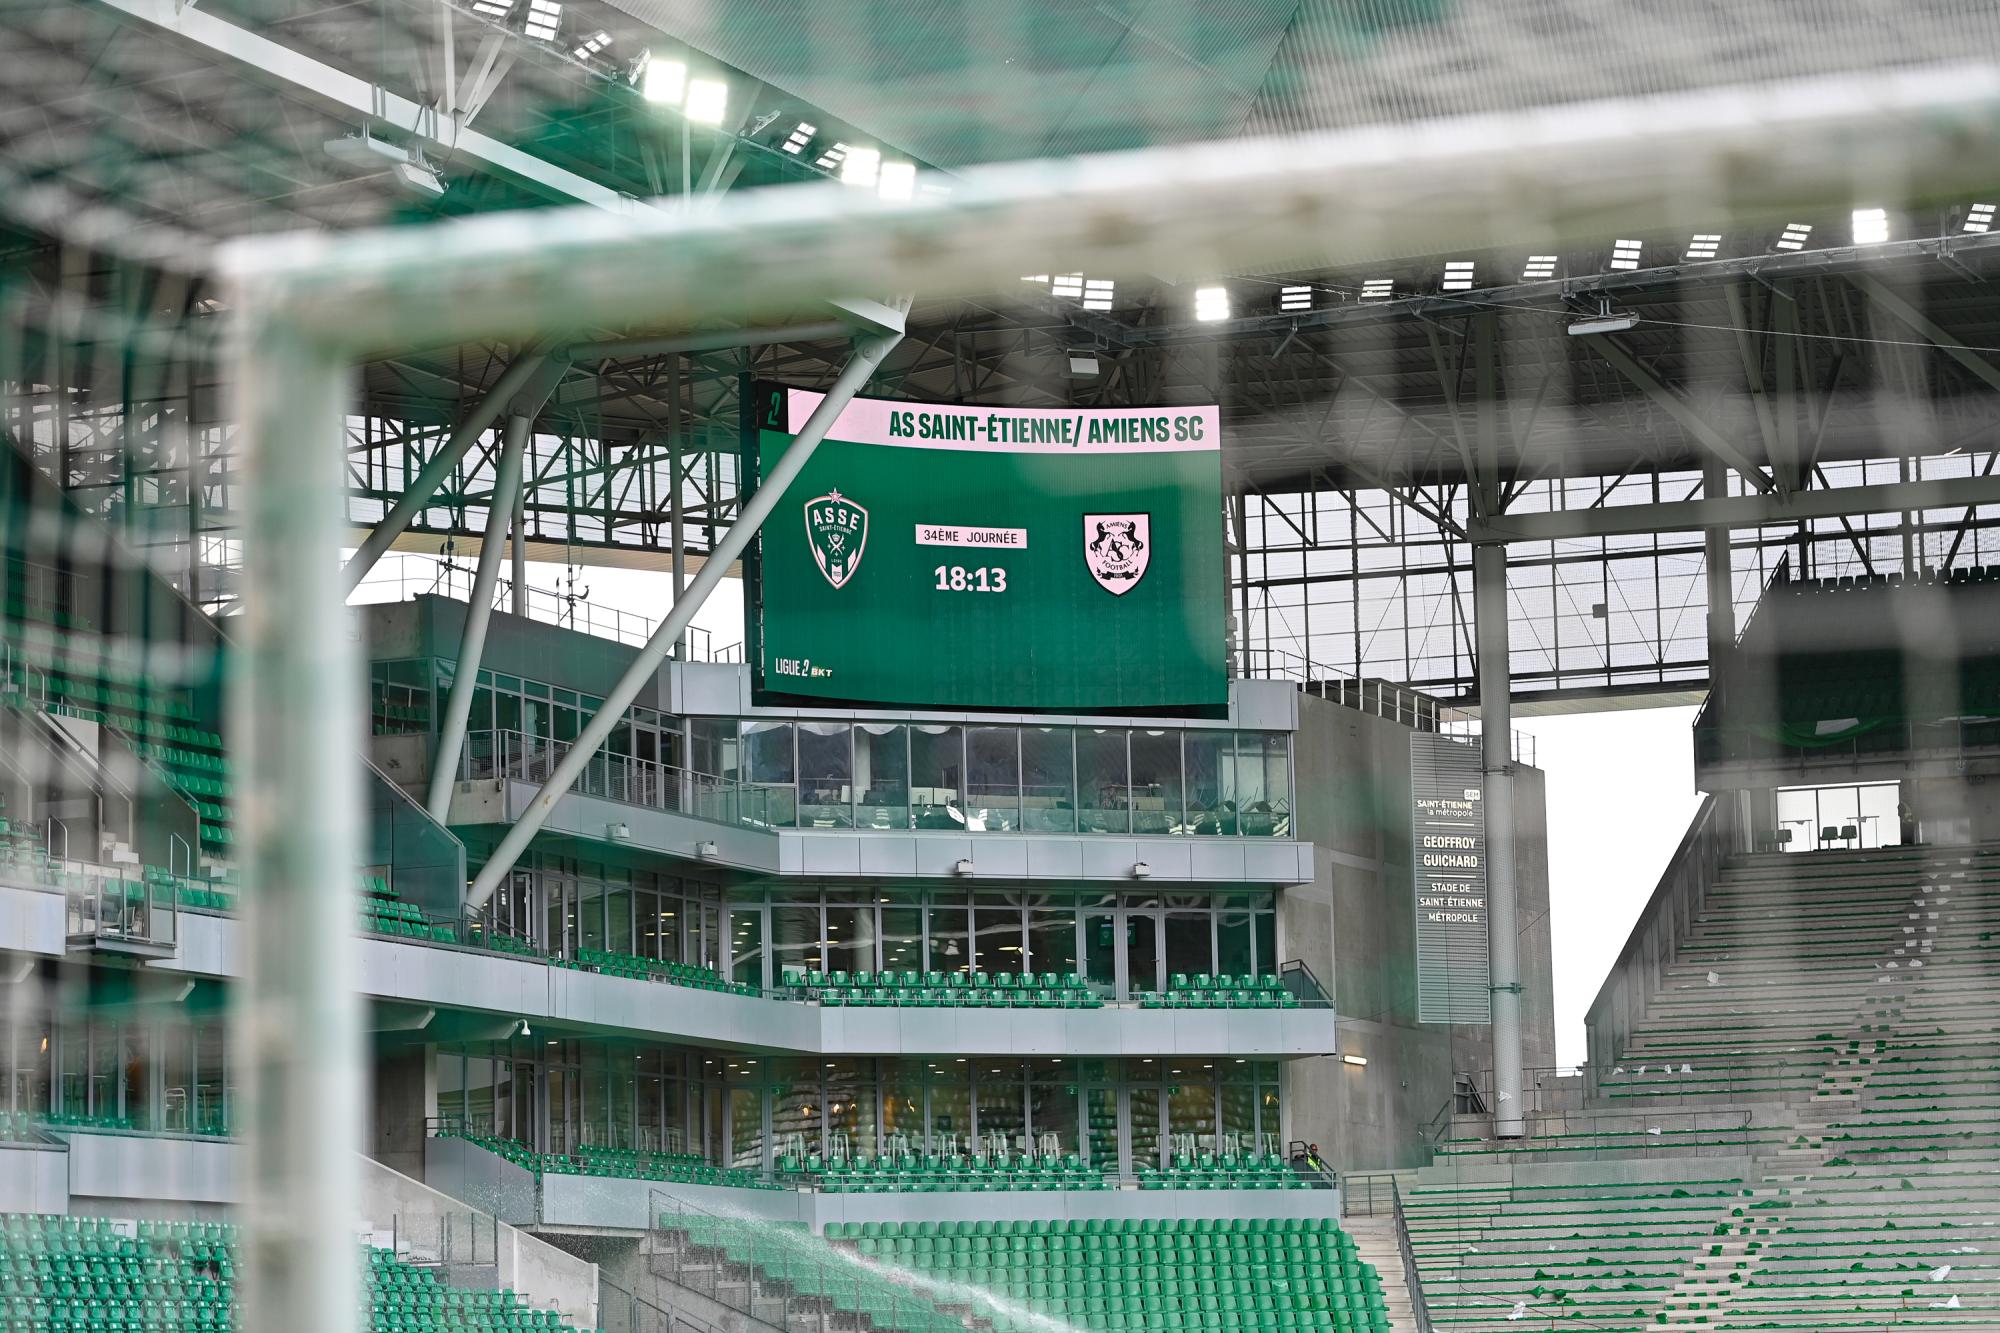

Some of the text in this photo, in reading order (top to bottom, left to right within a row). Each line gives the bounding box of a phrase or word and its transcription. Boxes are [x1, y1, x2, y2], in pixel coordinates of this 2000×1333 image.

[767, 391, 781, 426] 2
[889, 410, 915, 438] AS
[1087, 416, 1170, 444] AMIENS
[1174, 415, 1204, 442] SC
[813, 507, 860, 530] ASSE
[1106, 521, 1128, 529] AMIENS
[924, 528, 1018, 544] 34ÈME JOURNÉE
[1102, 559, 1133, 571] FOOTBALL
[934, 565, 1007, 593] 18:13
[775, 657, 833, 678] LIGUE 2 BKT
[1465, 790, 1479, 798] SEM
[1417, 799, 1473, 809] SAINT-ÉTIENNE
[1427, 807, 1473, 818] la métropole
[1423, 835, 1476, 849] GEOFFROY
[1423, 854, 1478, 868] GUICHARD
[1431, 882, 1471, 892] STADE DE
[1419, 895, 1484, 907] SAINT-ÉTIENNE
[1428, 911, 1478, 922] MÉTROPOLE
